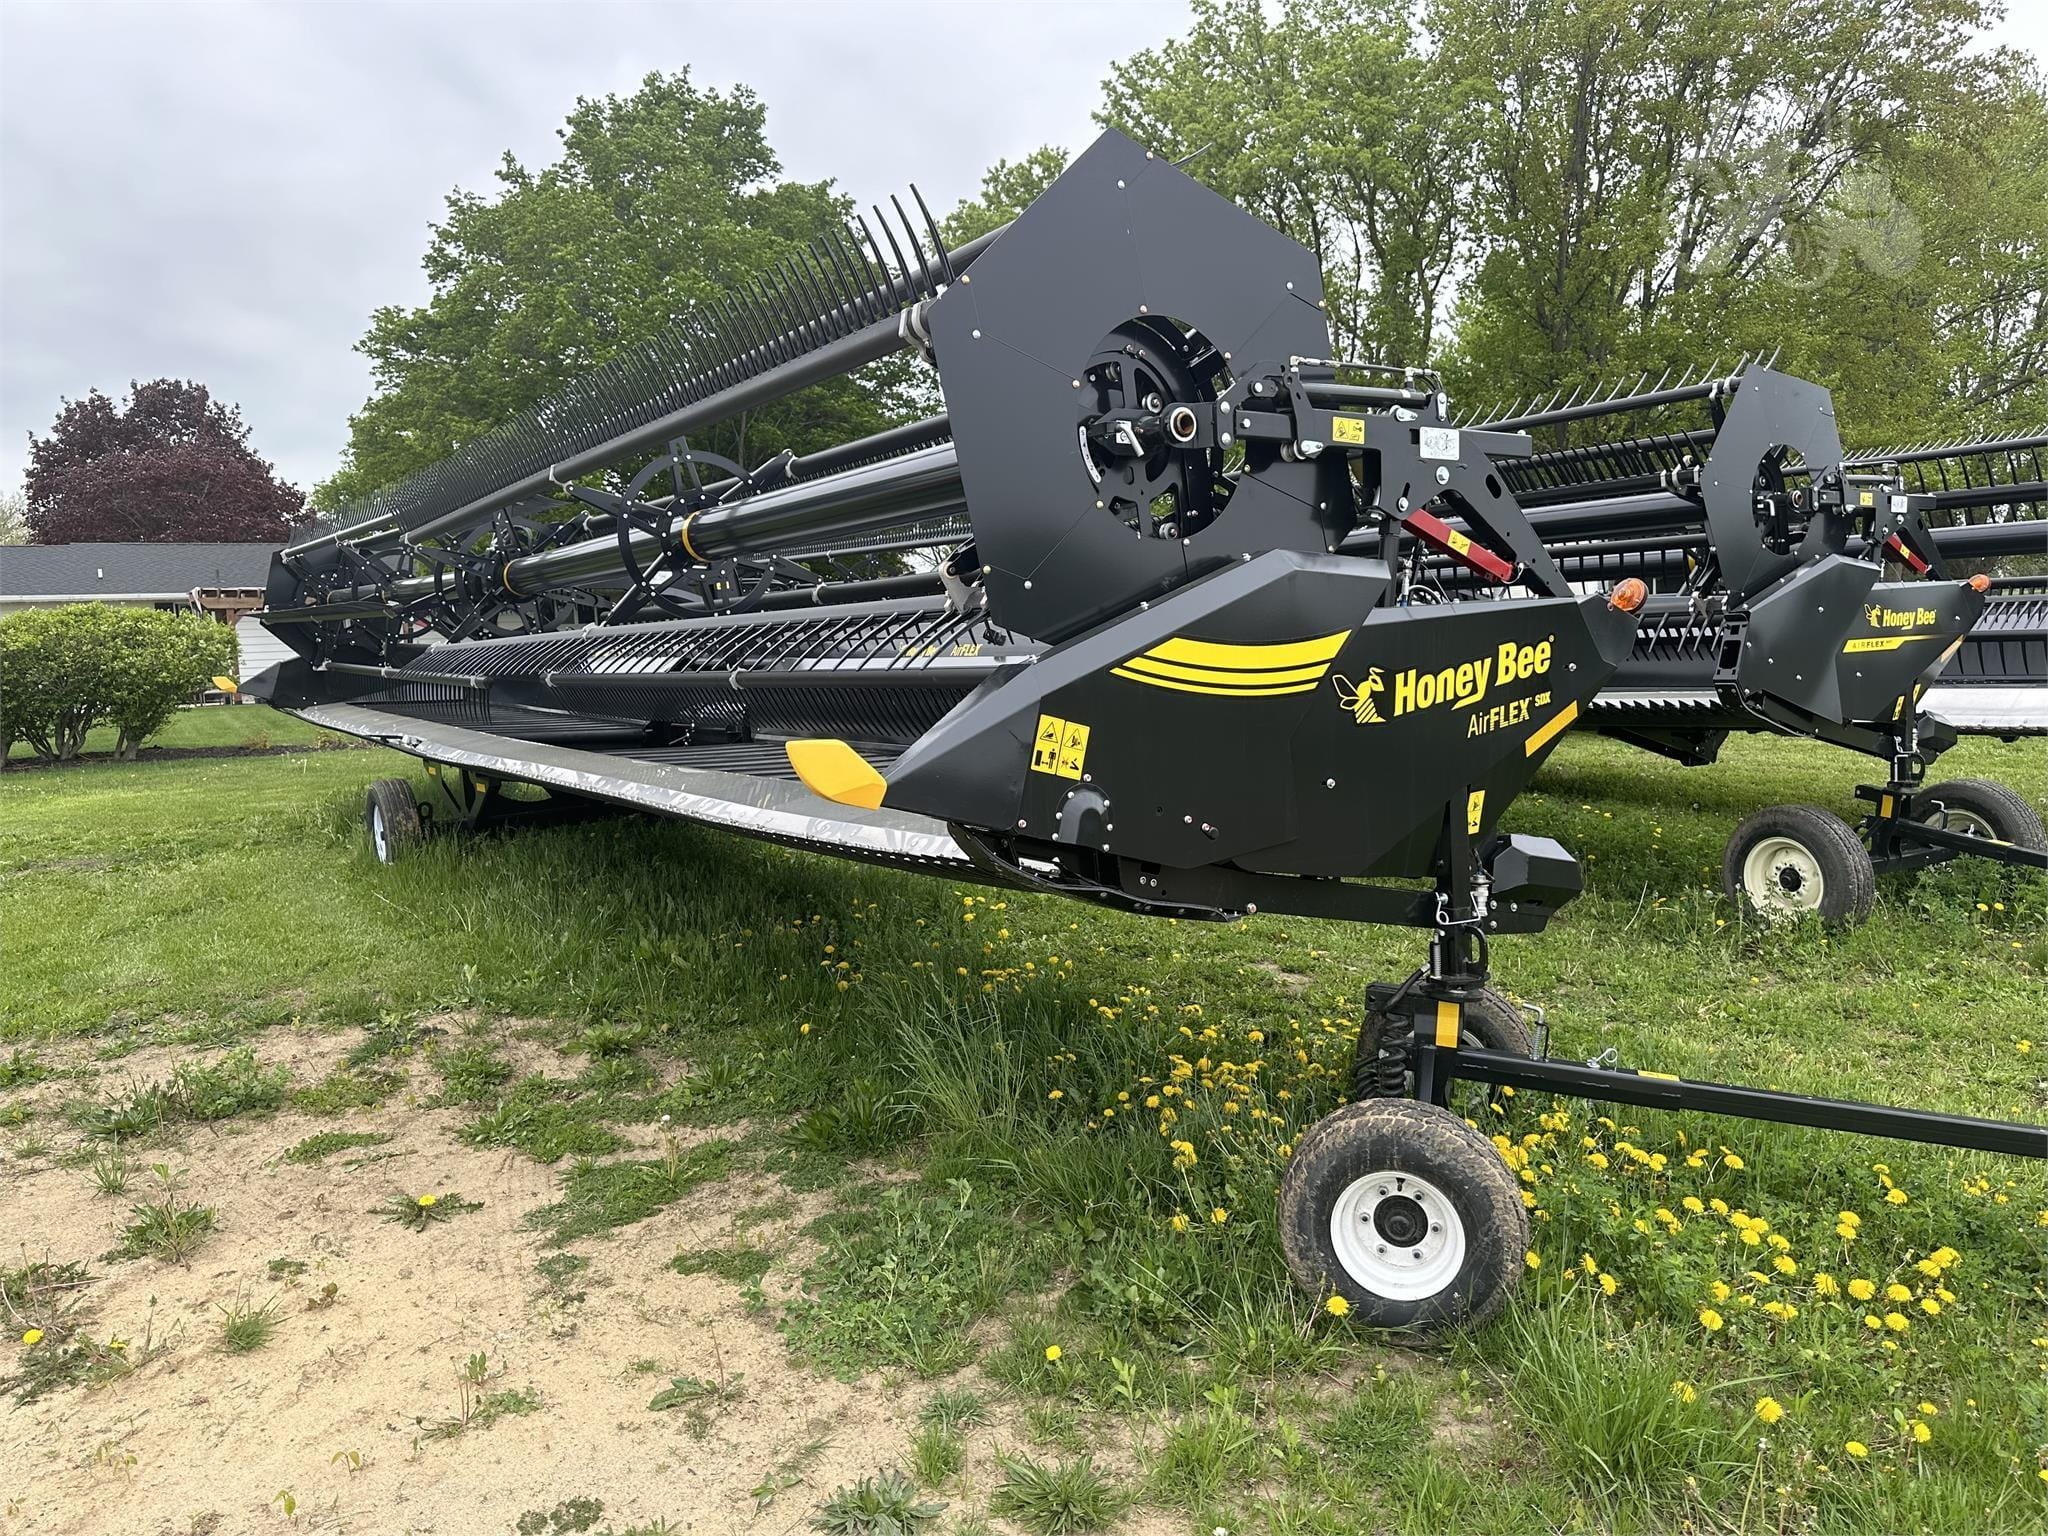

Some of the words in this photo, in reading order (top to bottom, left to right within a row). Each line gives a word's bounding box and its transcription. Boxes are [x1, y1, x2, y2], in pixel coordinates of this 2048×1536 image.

[1882, 609, 1916, 630] Honey
[1916, 607, 1936, 625] Bee
[1393, 657, 1492, 717] Honey
[1467, 697, 1530, 738] AirFLEX
